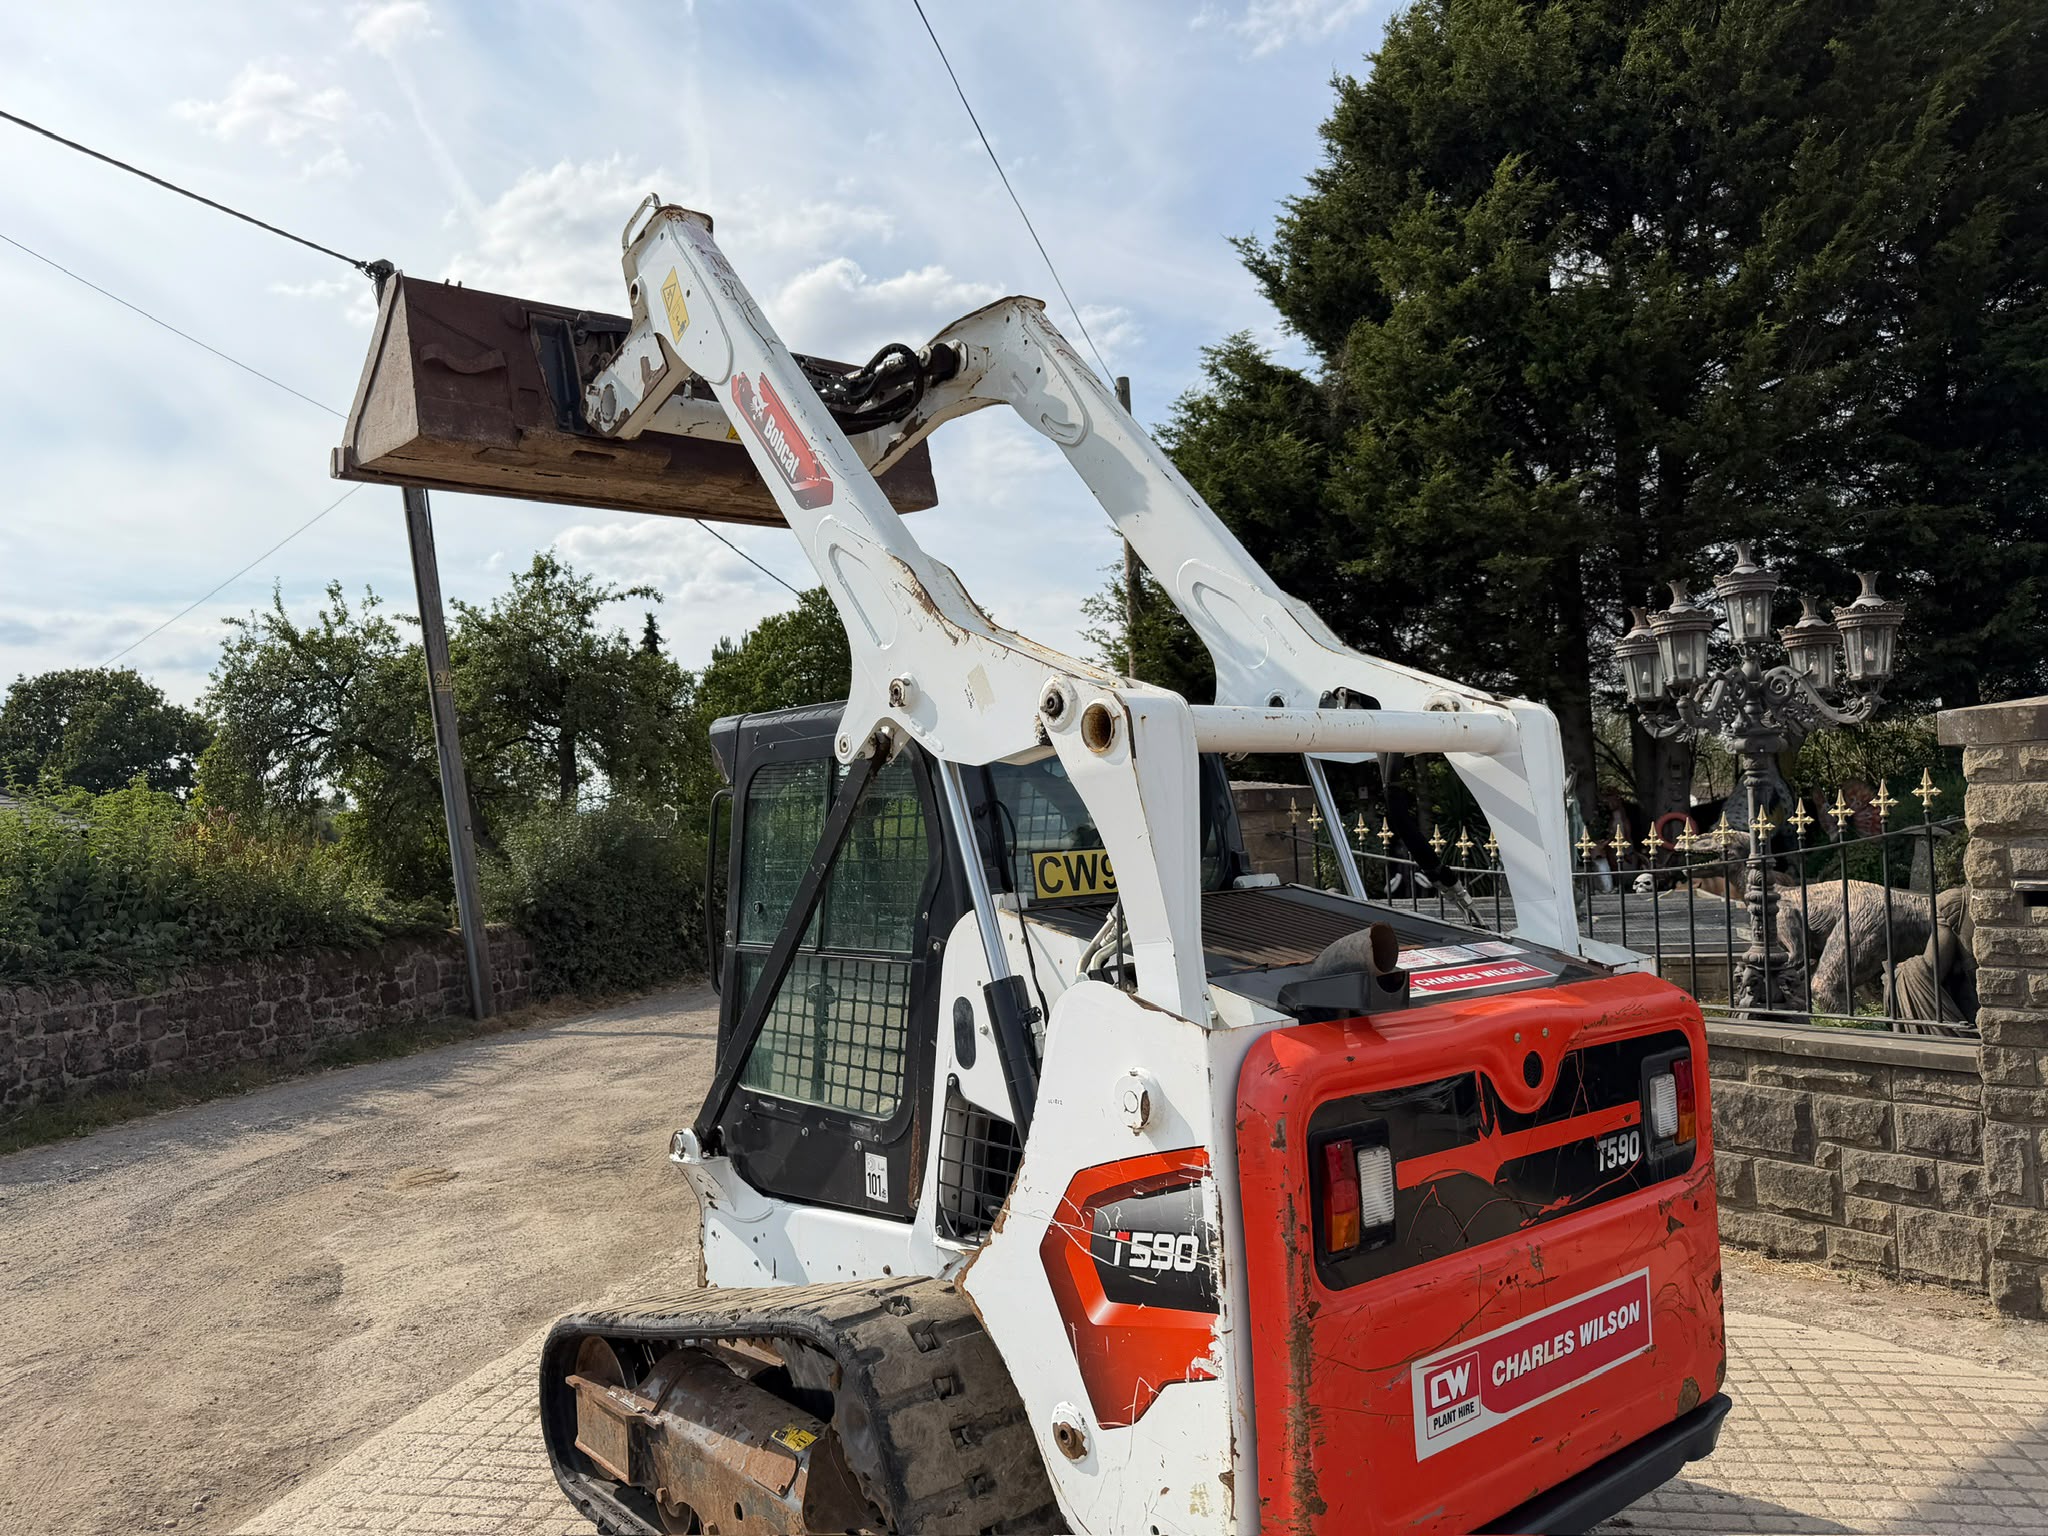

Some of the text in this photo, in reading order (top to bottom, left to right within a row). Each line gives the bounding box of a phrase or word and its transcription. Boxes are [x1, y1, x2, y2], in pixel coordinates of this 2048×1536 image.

[763, 414, 800, 479] Bobcat
[1413, 965, 1534, 987] CHARLES WILSON
[1597, 1130, 1640, 1172] T590
[867, 1172, 882, 1197] 101
[1109, 1230, 1200, 1273] T590
[1491, 1300, 1640, 1388] CHARLES WILSON
[1430, 1361, 1471, 1409] CW
[1433, 1401, 1475, 1431] PLANT HIRE
